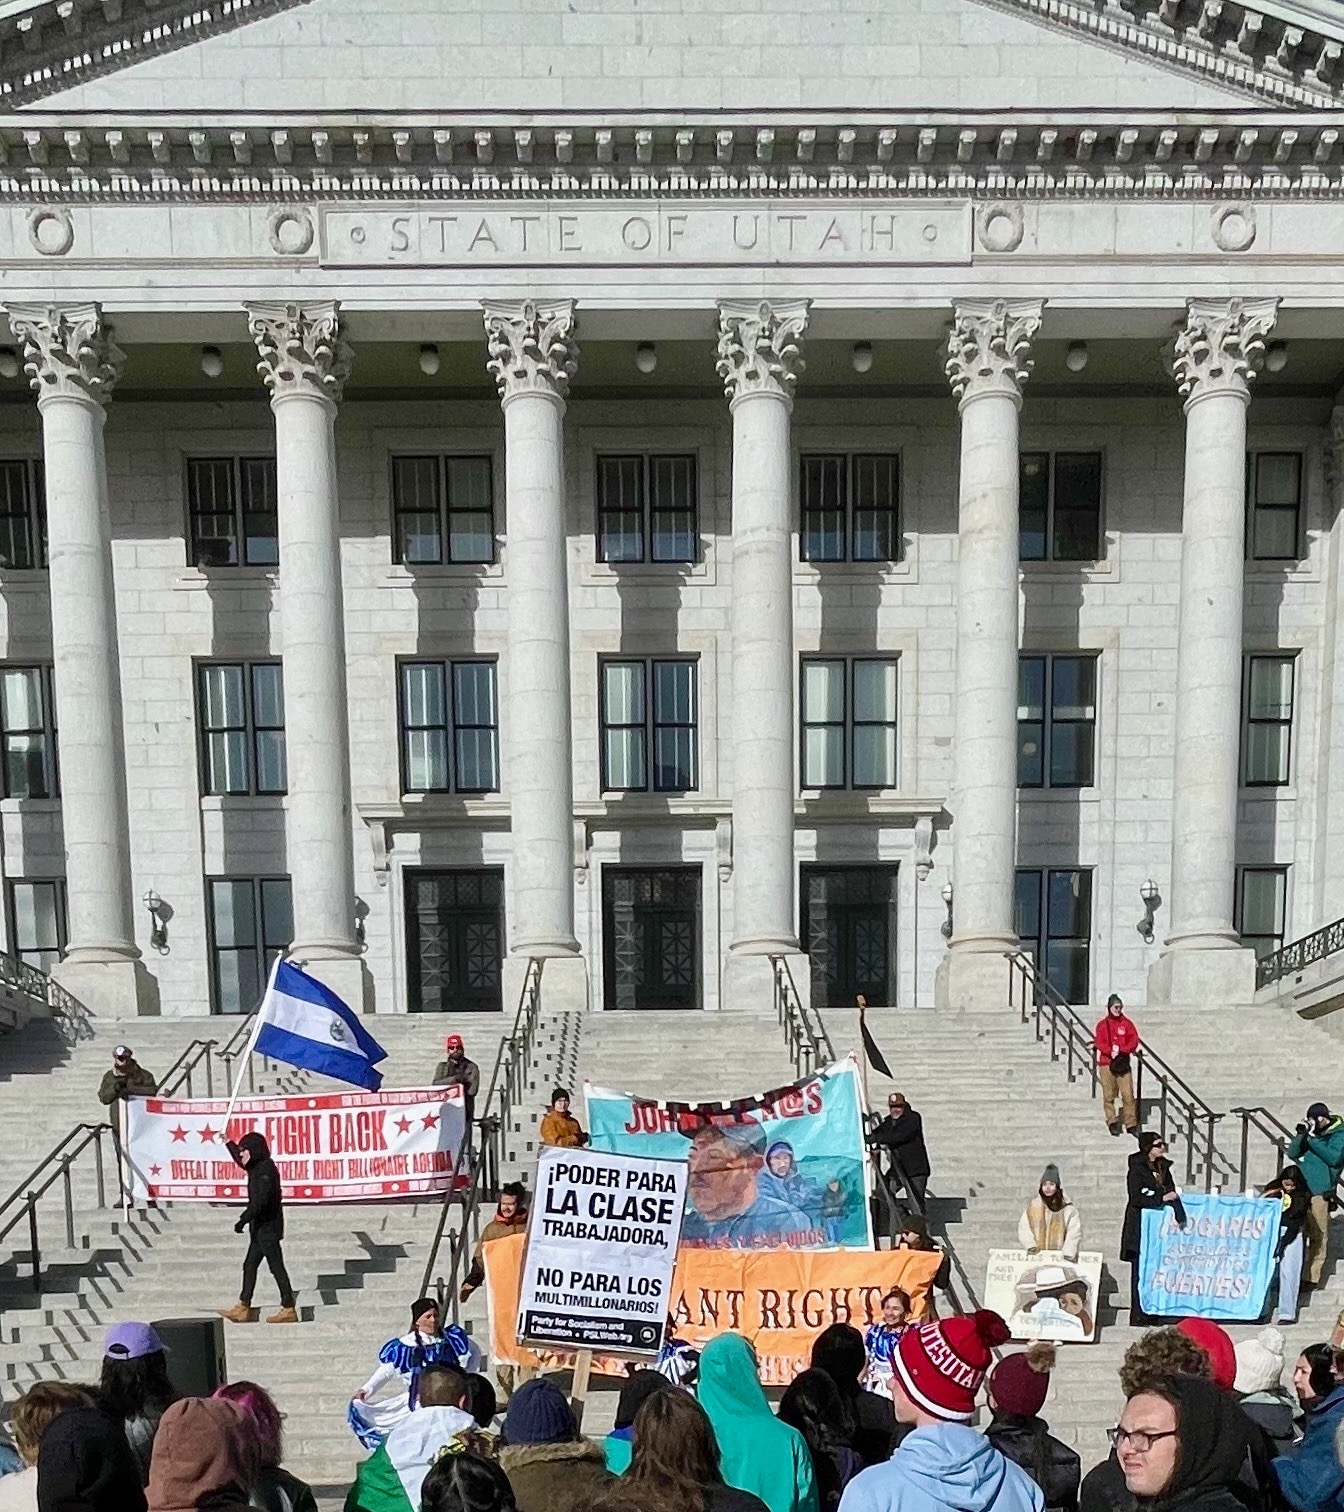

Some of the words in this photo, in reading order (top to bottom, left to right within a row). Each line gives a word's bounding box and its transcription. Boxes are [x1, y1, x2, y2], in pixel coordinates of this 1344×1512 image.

[390, 215, 583, 252] STATE
[620, 215, 689, 252] OF
[731, 214, 897, 251] UTAH
[265, 1115, 322, 1156] FIGHT
[329, 1110, 388, 1153] BACK
[170, 1159, 207, 1180] DEFEAT
[313, 1159, 344, 1180] RIGHT
[413, 1150, 453, 1173] AGENDA
[548, 1162, 621, 1188] ¡PODER
[626, 1170, 677, 1194] PARA
[545, 1187, 579, 1217] LA
[588, 1192, 674, 1225] CLASE
[542, 1219, 669, 1250] TRABAJADORA,
[536, 1267, 564, 1288] NO
[569, 1271, 621, 1294] PARA
[627, 1276, 663, 1297] LOS
[534, 1291, 660, 1315] MULTIMILLONARIOS!
[759, 1286, 882, 1329] RIGHT
[530, 1315, 553, 1328] Party
[555, 1318, 567, 1328] for
[567, 1319, 607, 1330] Socialism
[608, 1322, 624, 1331] and
[530, 1325, 573, 1337] Liberation
